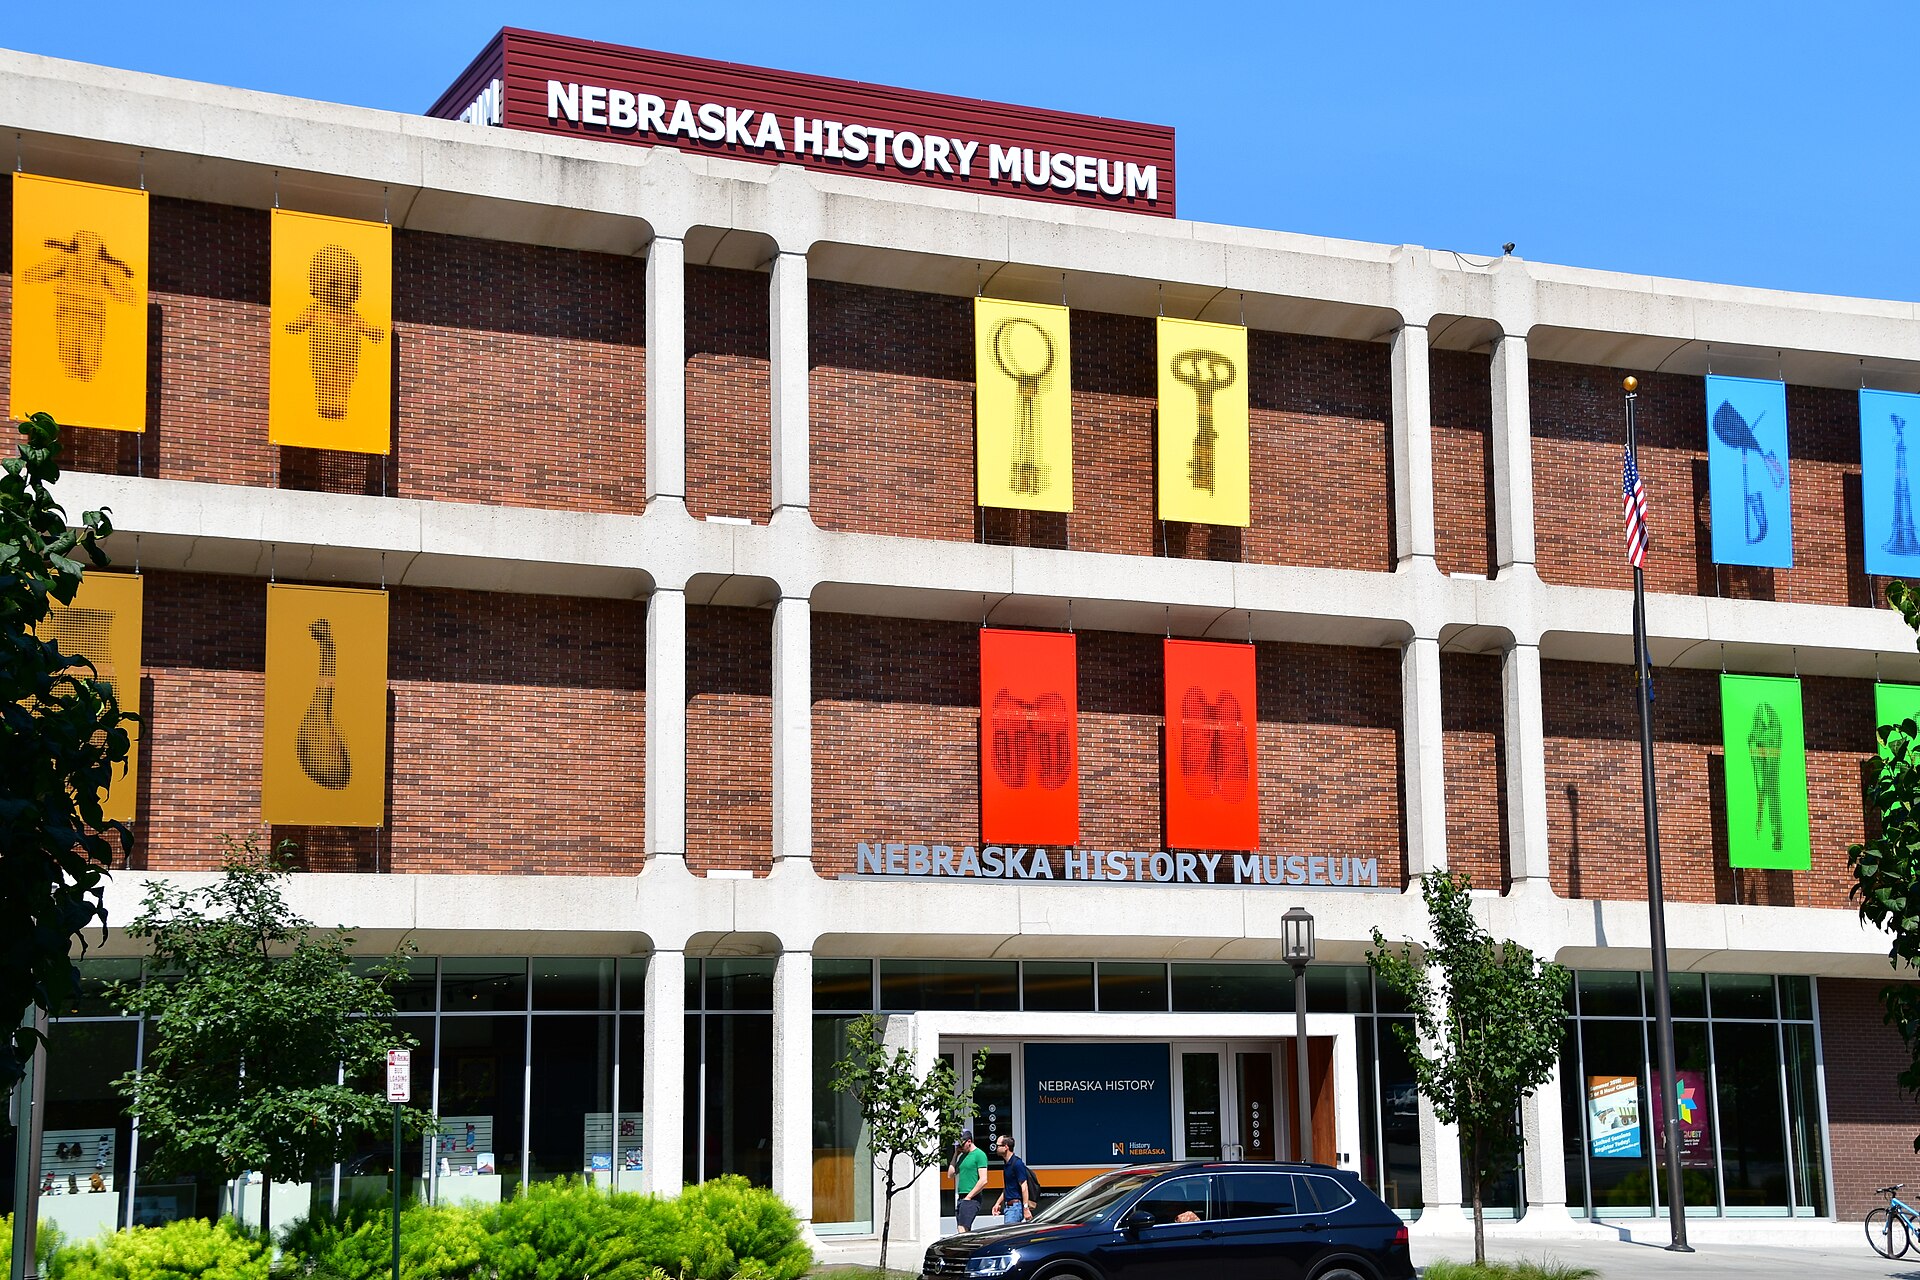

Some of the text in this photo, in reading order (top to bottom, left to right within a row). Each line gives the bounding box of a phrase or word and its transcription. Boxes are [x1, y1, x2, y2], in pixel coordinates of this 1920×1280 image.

[547, 80, 785, 151] NEBRASKA
[793, 116, 979, 176] HISTORY
[988, 143, 1159, 201] MUSEUM
[856, 842, 1378, 887] NEBRASKA HISTORY MUSEUM
[1038, 1080, 1155, 1091] NEBRASKA HISTORY
[1038, 1095, 1074, 1104] Museum
[1592, 1132, 1632, 1147] Limited Sessions
[1594, 1138, 1631, 1154] Register Today!
